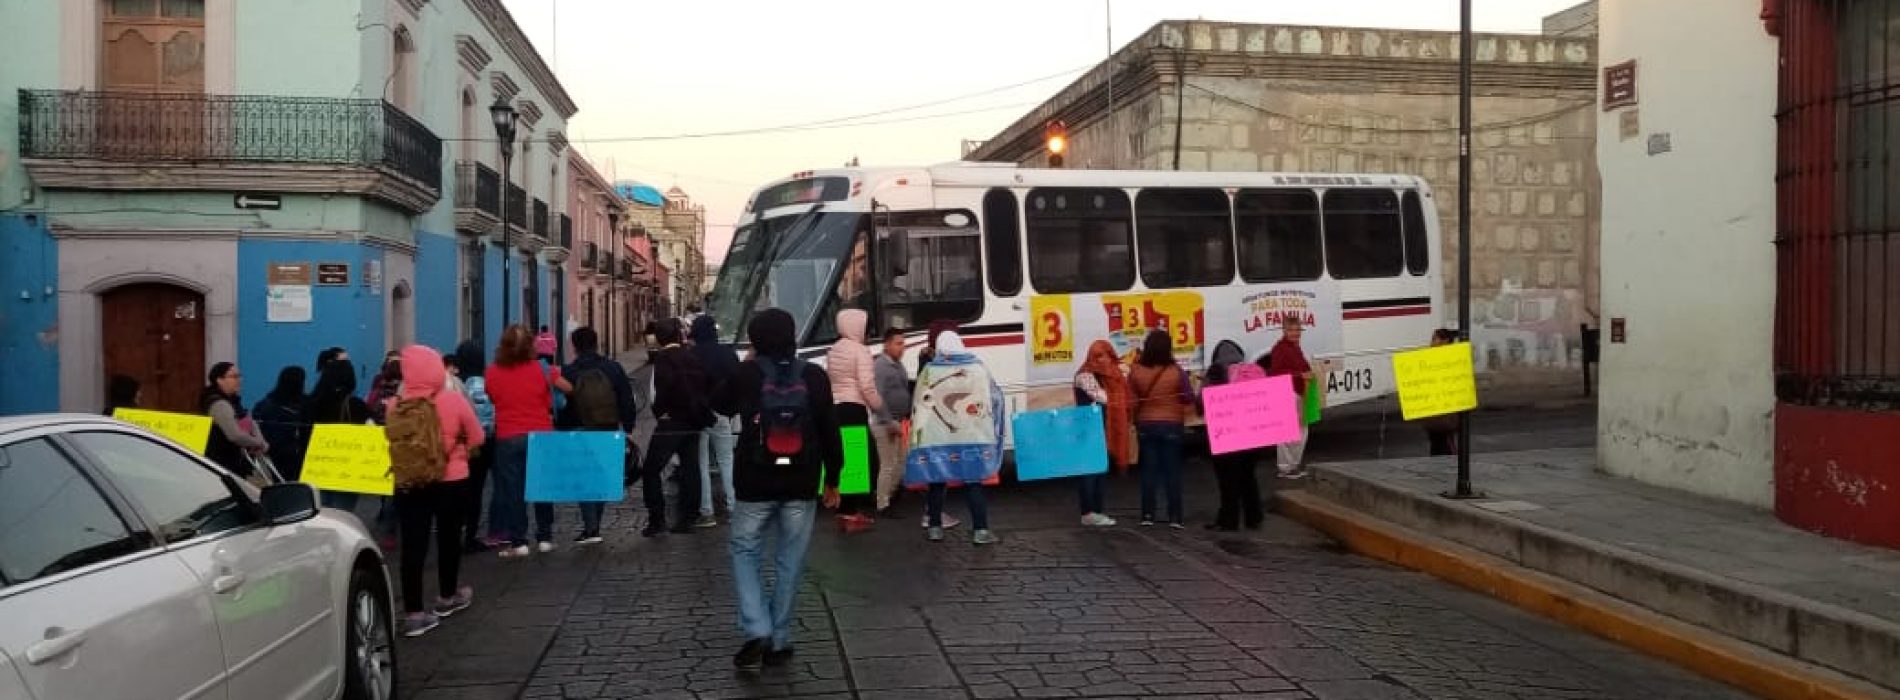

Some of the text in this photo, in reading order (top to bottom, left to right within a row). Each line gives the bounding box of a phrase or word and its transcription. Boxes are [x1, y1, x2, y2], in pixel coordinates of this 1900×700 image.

[1128, 308, 1139, 328] 3
[1243, 315, 1262, 333] LA
[1042, 311, 1063, 349] 3
[1176, 322, 1189, 345] 3
[1327, 368, 1373, 393] A-013
